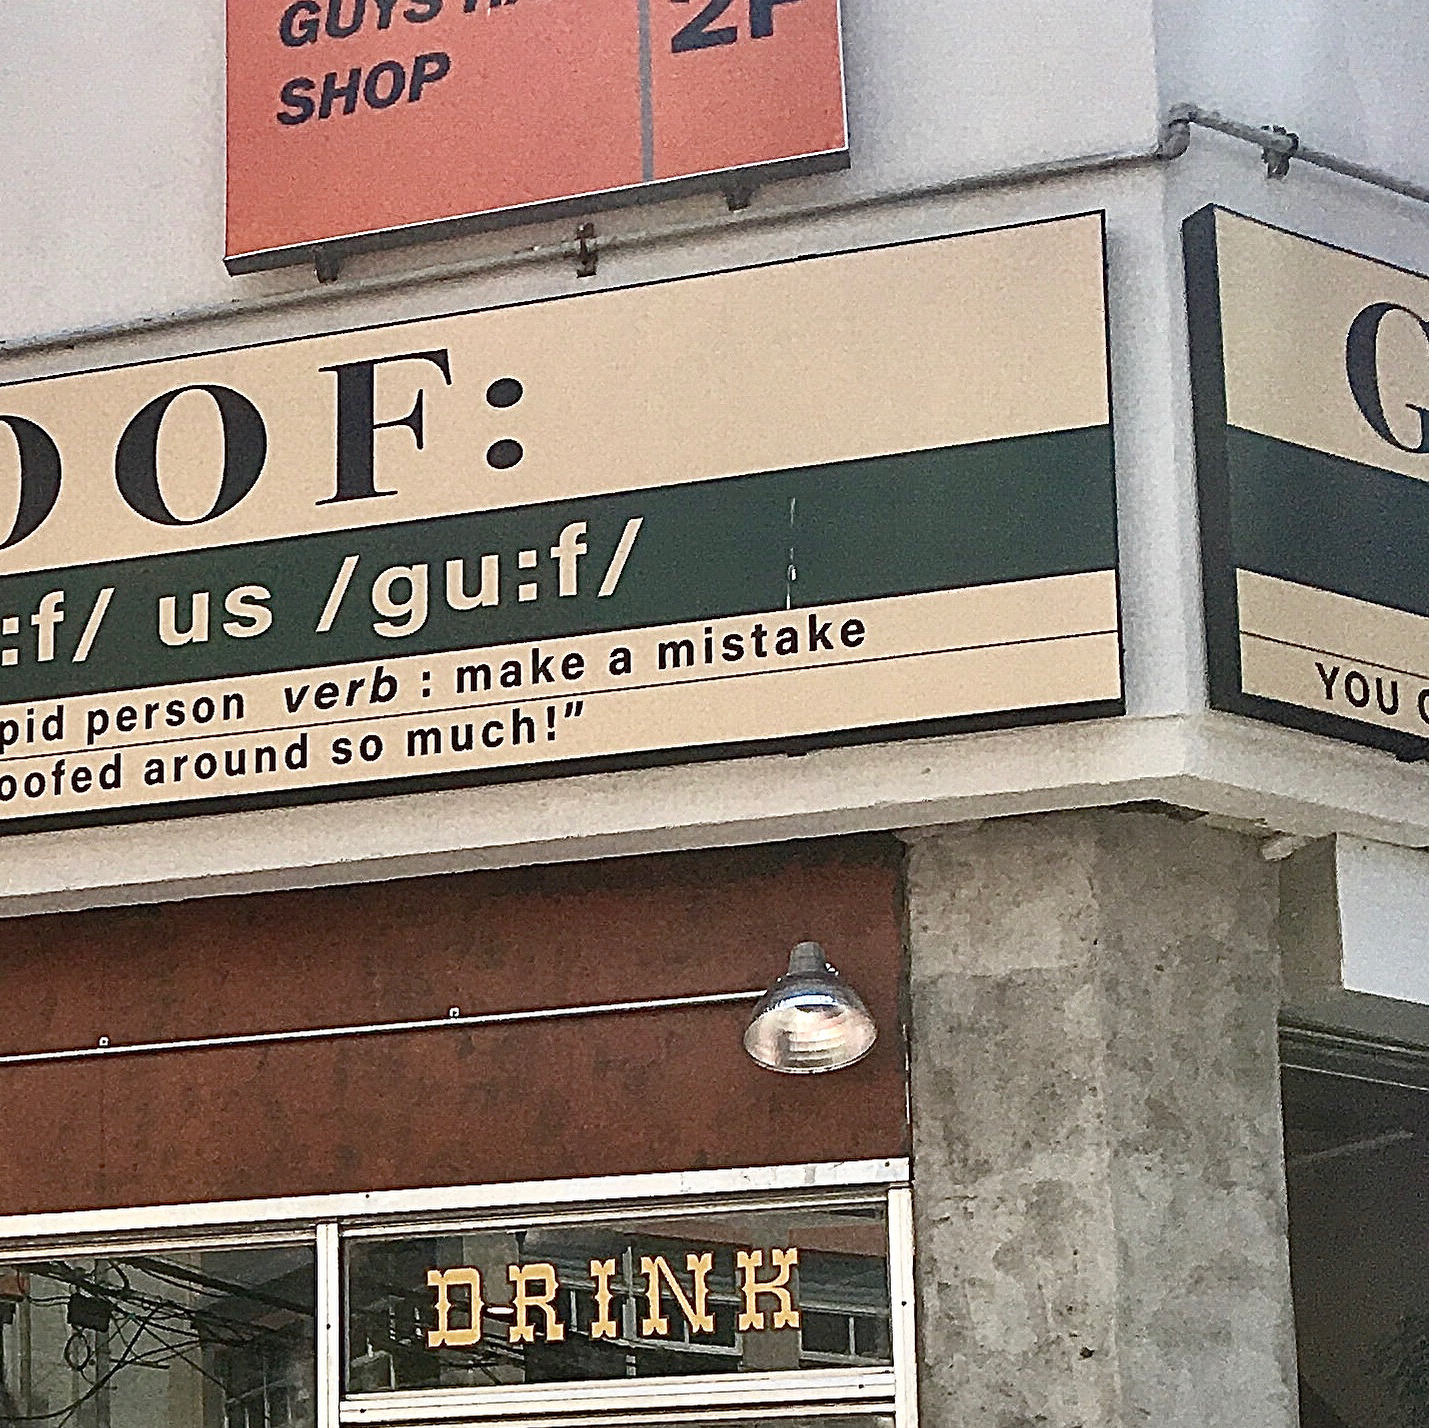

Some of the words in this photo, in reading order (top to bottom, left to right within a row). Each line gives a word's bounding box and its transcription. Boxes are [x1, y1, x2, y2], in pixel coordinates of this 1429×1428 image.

[276, 51, 451, 126] SHOP
[158, 583, 273, 645] us
[316, 517, 644, 638] /gu:f/
[86, 690, 245, 745] person
[284, 666, 399, 714] verb
[456, 647, 585, 693] make
[609, 646, 634, 676] a
[657, 614, 867, 668] mistake
[1315, 662, 1399, 716] YOU
[143, 731, 310, 783] around
[330, 728, 383, 764] so
[426, 1247, 801, 1349] DRINK
